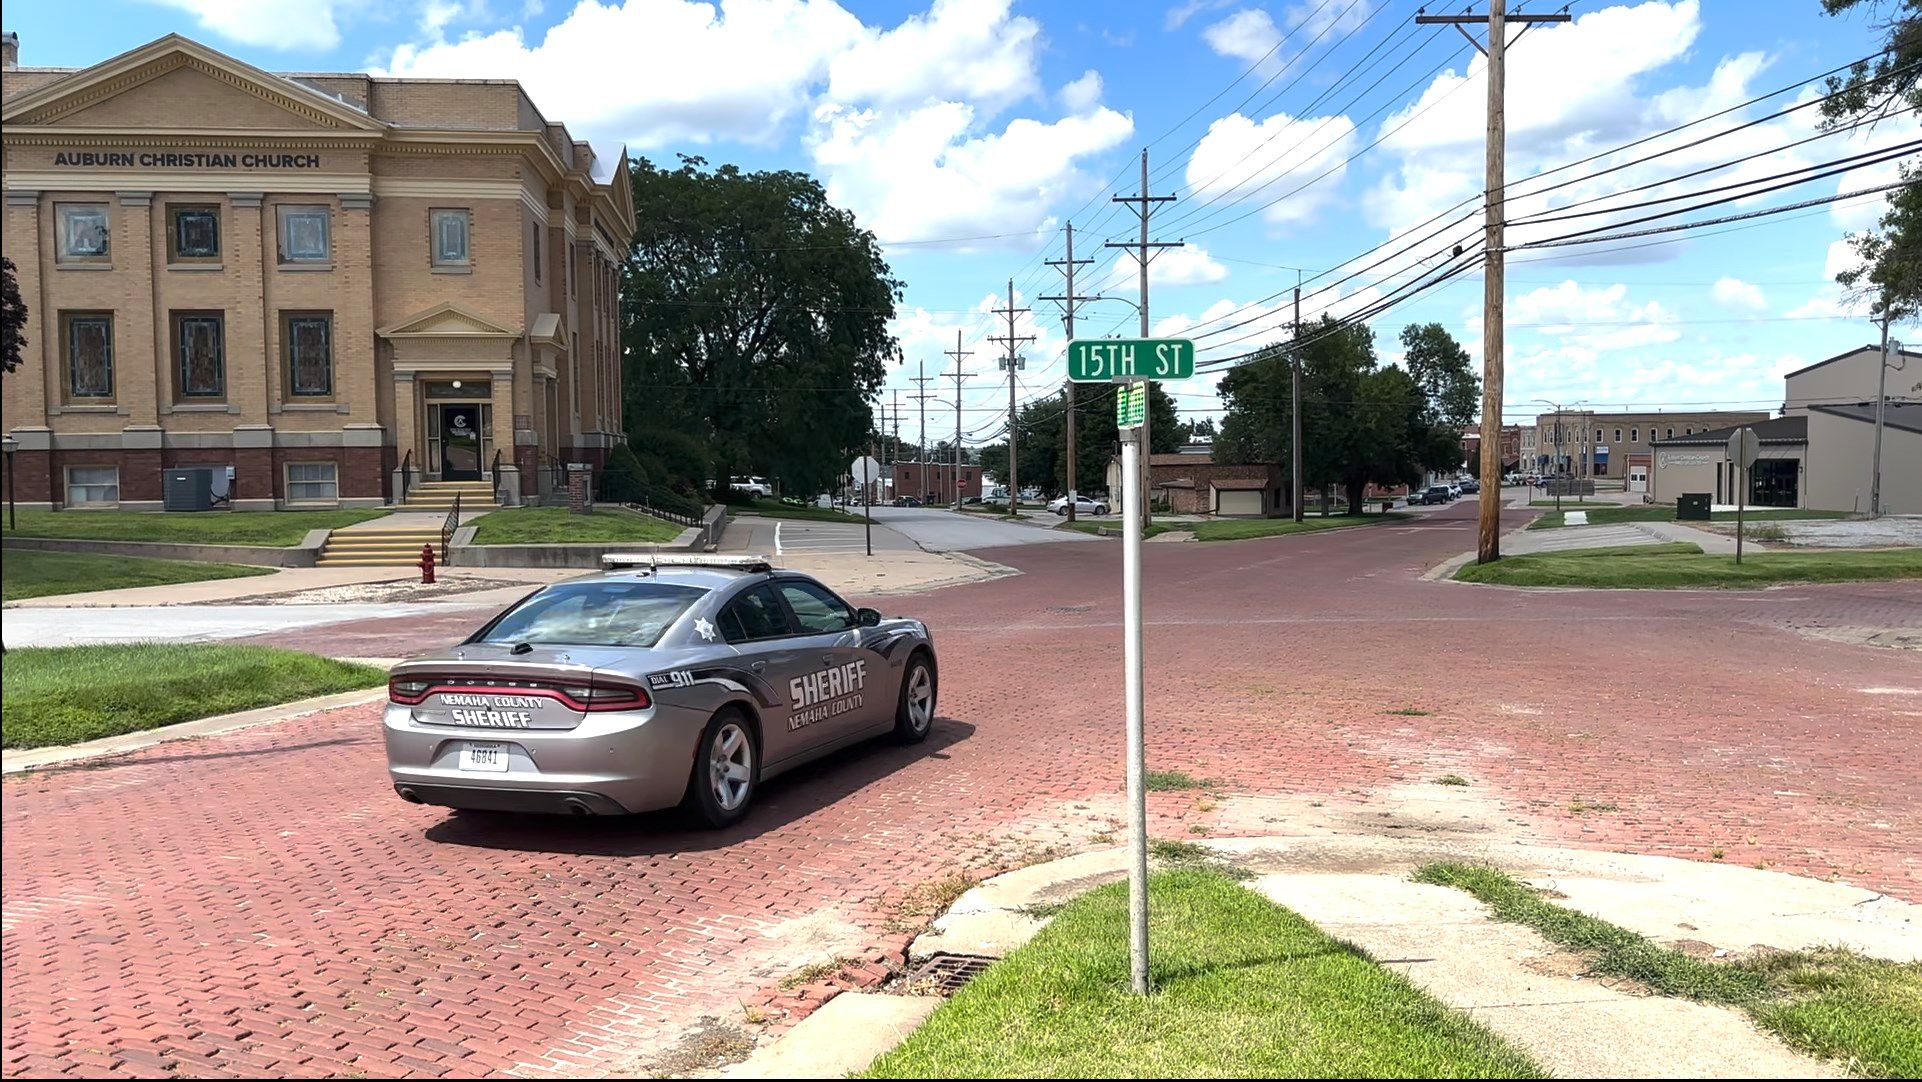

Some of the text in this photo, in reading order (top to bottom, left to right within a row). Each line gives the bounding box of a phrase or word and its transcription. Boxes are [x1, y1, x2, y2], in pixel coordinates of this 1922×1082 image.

[54, 152, 320, 168] AUBURN CHRISTIAN CHURCH
[1079, 343, 1183, 377] 15TH ST
[650, 675, 668, 685] DIAL
[669, 670, 695, 688] 911
[789, 658, 867, 711] SHERIFF
[440, 693, 864, 732] NEMAHA COUNTY NEMAHA COUNTY
[452, 709, 532, 728] SHERIFF
[470, 749, 498, 765] 46841
